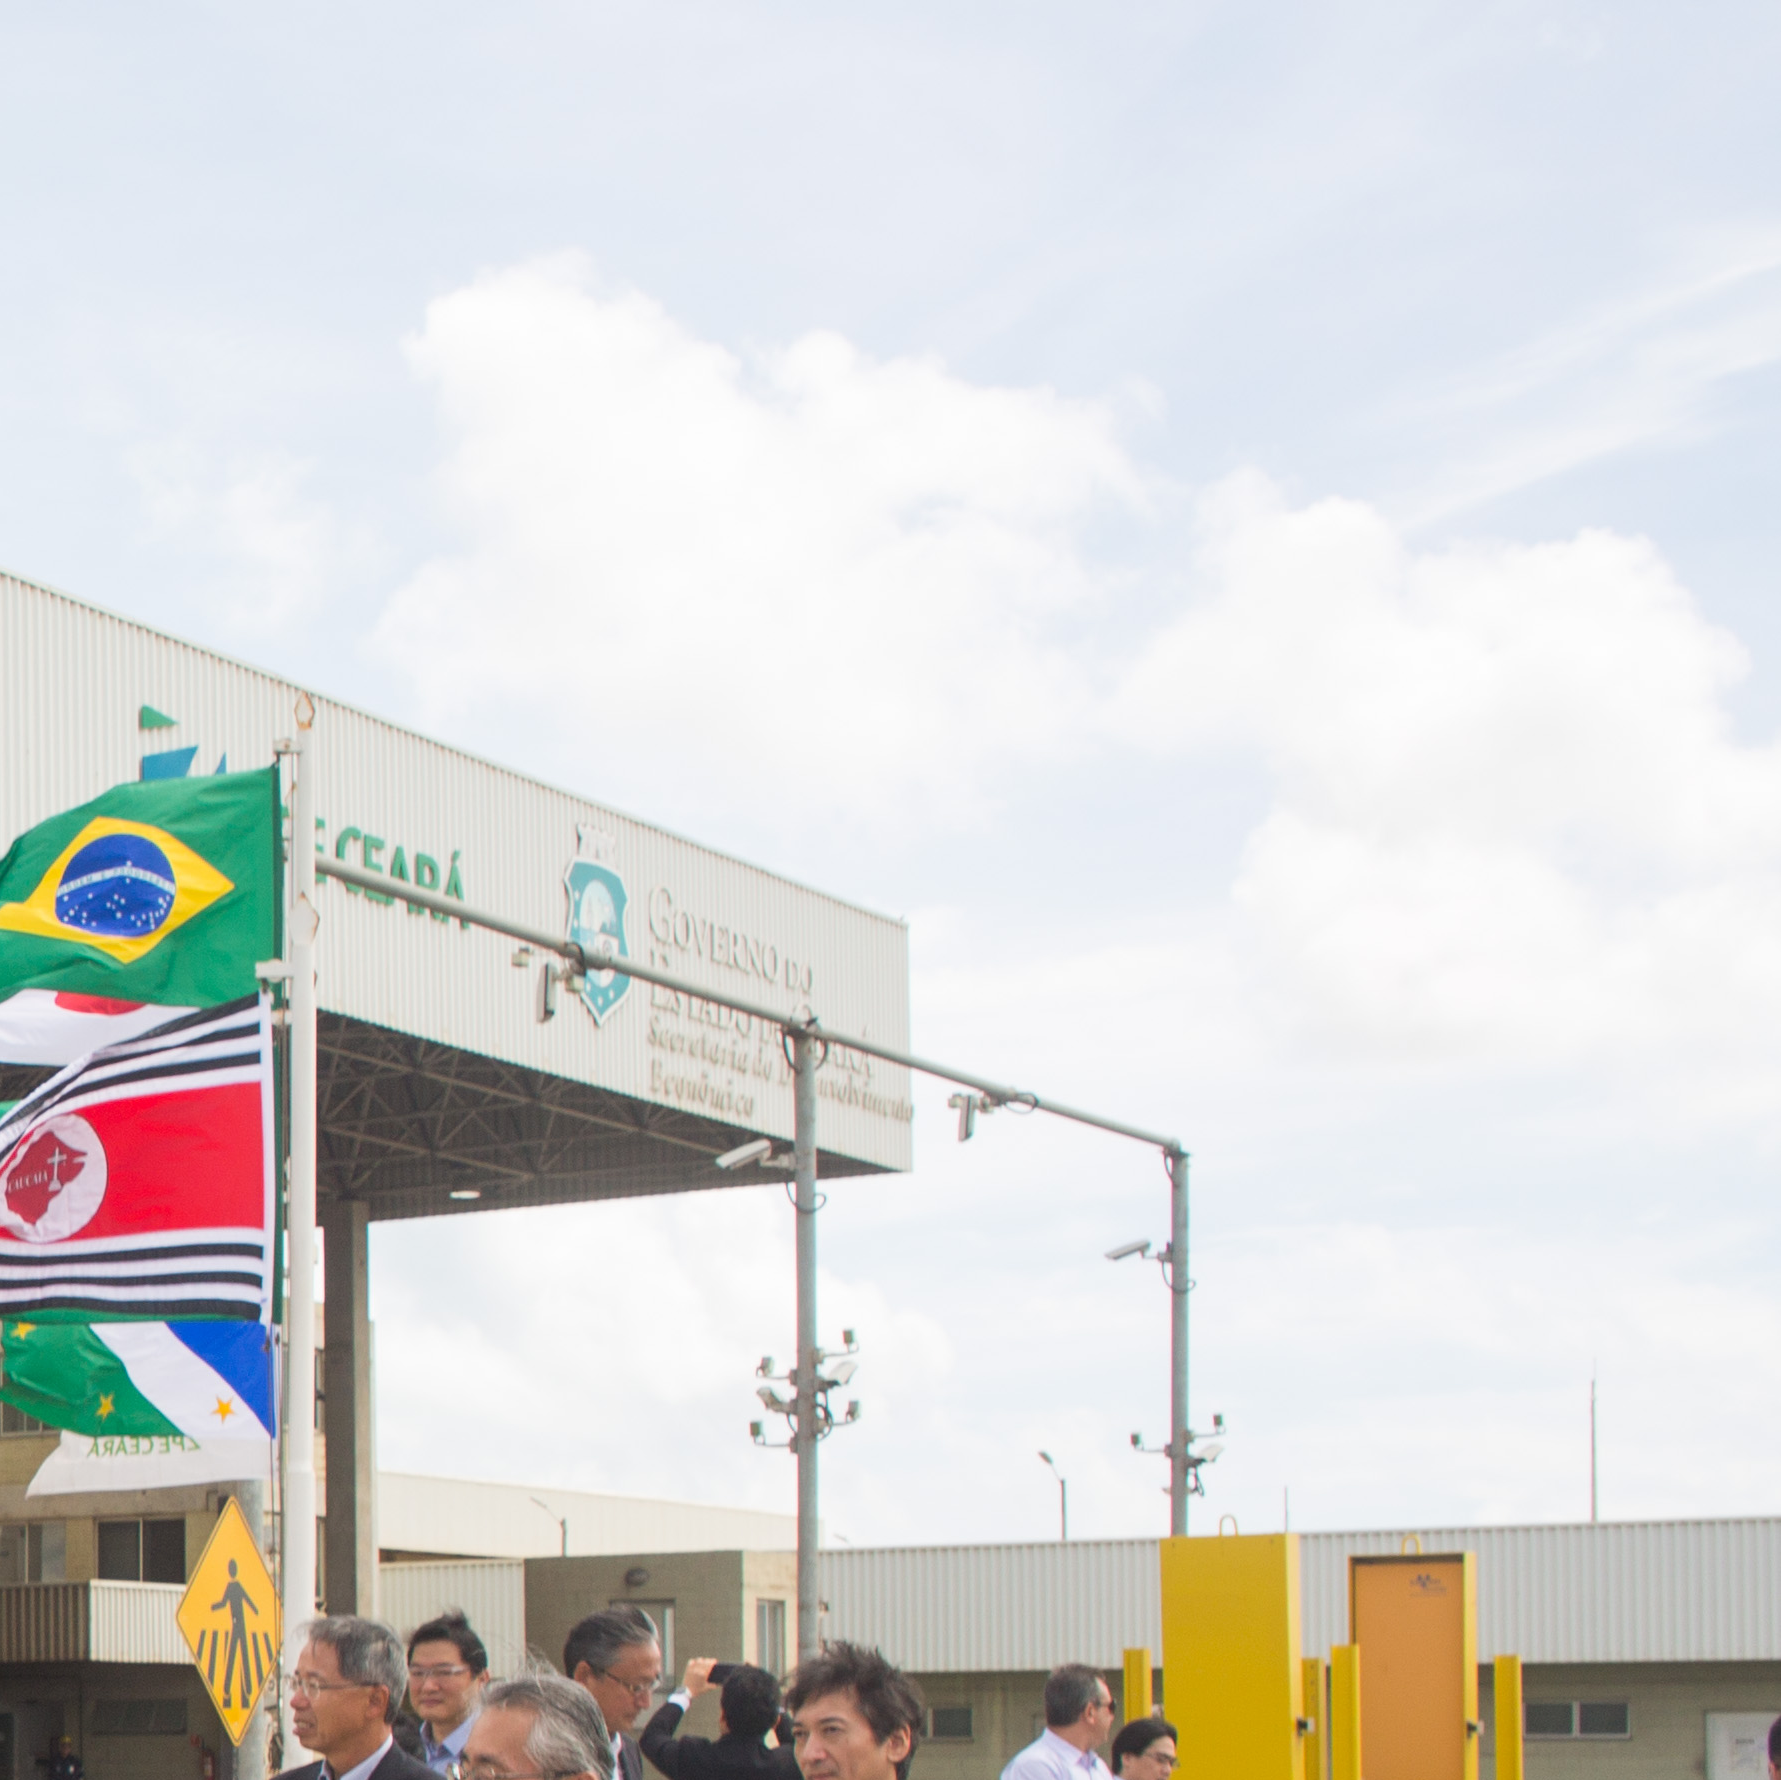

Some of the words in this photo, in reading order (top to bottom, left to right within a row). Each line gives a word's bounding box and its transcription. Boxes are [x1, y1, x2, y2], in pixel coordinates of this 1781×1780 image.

[336, 825, 470, 930] CEARÁ
[648, 886, 779, 984] GOVERNO
[785, 957, 814, 996] DO
[647, 1013, 749, 1075] Secretaria
